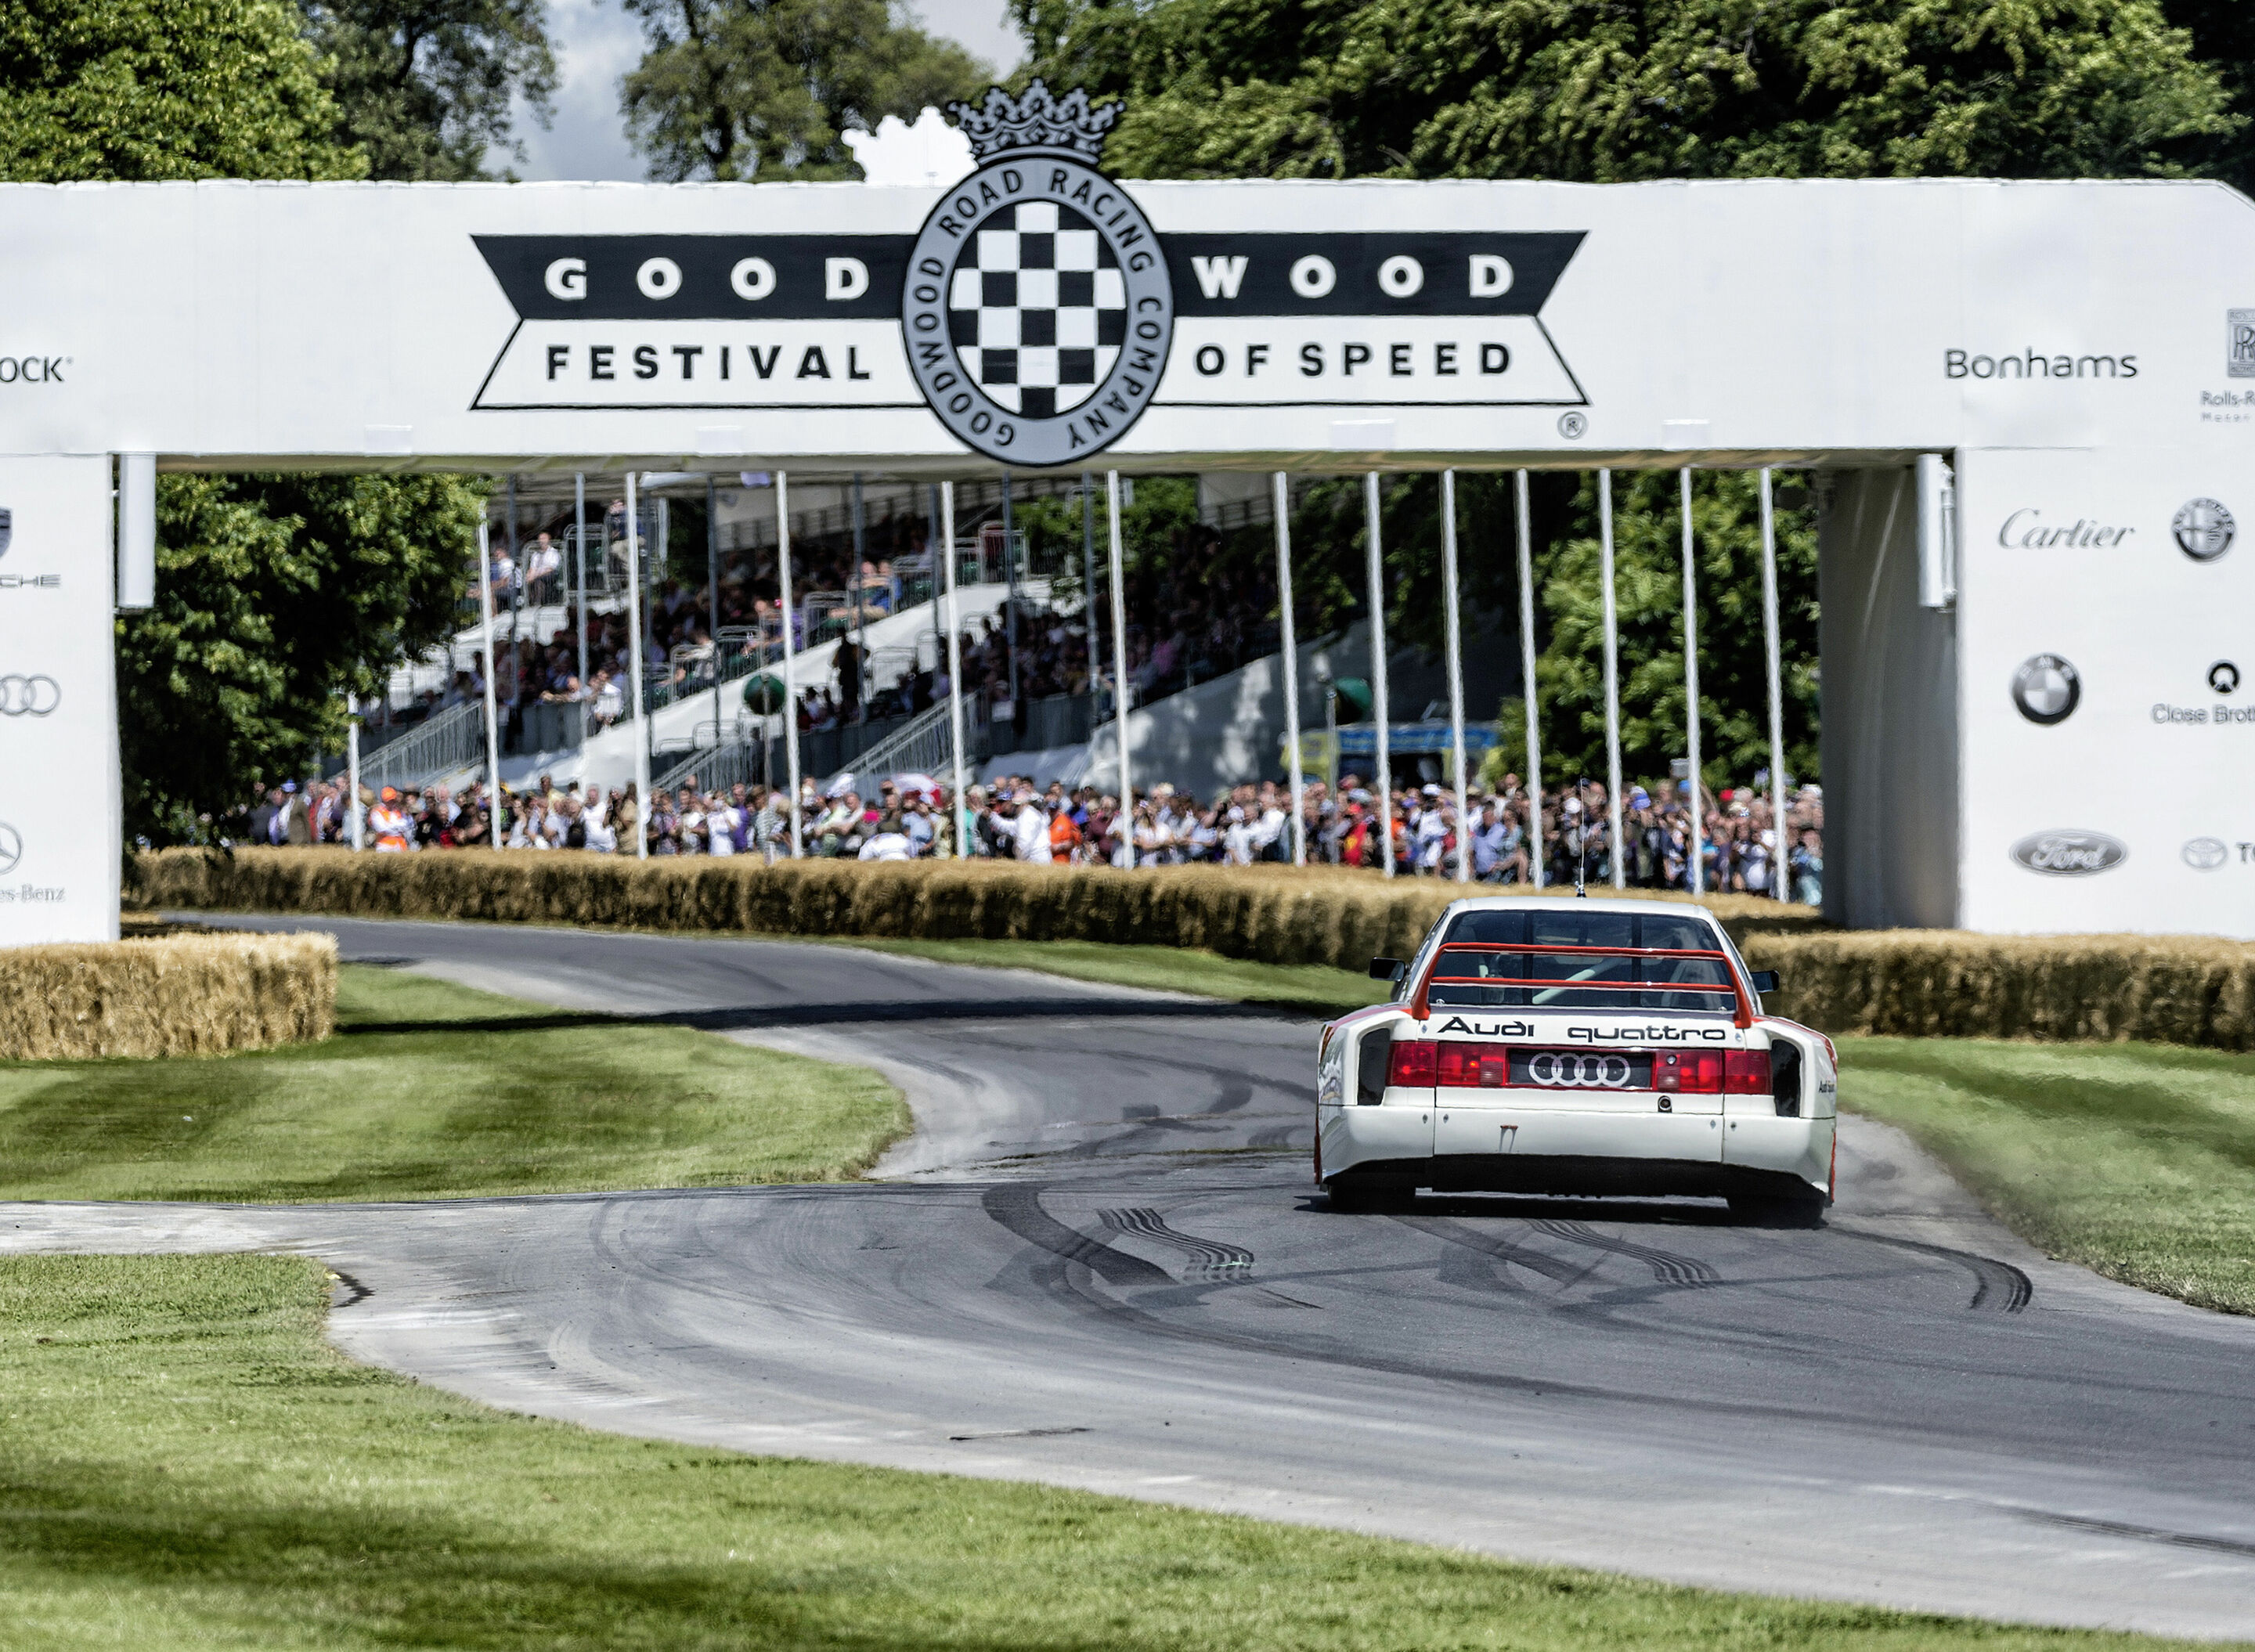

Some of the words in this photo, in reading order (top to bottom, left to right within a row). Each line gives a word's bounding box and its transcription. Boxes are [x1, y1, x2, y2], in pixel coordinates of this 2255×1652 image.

[939, 169, 1022, 238] ROAD
[1050, 169, 1154, 272] RACING
[545, 257, 870, 300] GOOD
[1192, 255, 1514, 298] WOOD
[547, 345, 872, 381] FESTIVAL
[1195, 343, 1270, 377] OF
[1300, 342, 1510, 377] SPEED
[915, 257, 1016, 446] GOODWOOD
[1067, 297, 1162, 449] COMPANY
[1945, 346, 2138, 379] Bonhams
[1997, 507, 2136, 550] Cartier
[2152, 703, 2208, 724] Close
[2031, 836, 2109, 870] Ford
[1438, 1016, 1535, 1037] Audi
[1568, 1025, 1726, 1043] quattro
